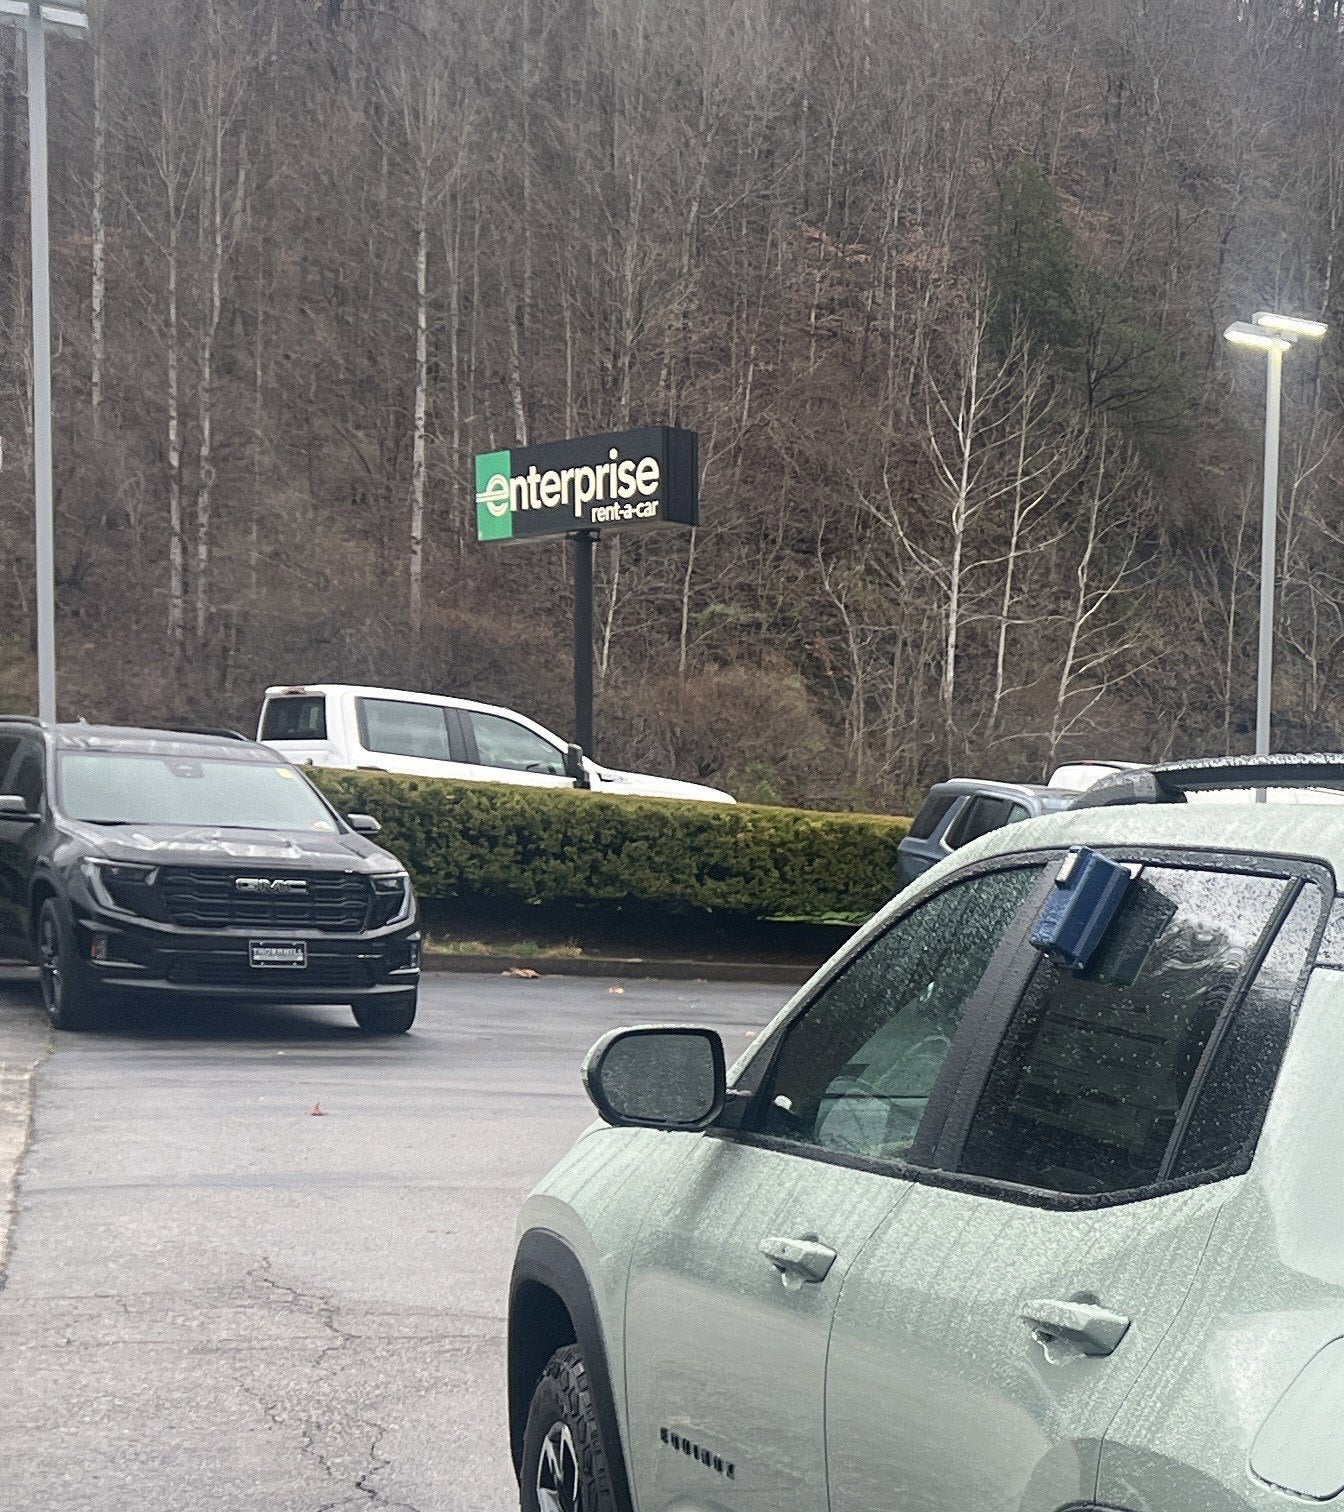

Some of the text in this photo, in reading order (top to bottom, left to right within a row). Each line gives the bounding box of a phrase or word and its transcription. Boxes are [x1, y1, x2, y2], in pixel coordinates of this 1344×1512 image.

[476, 448, 660, 517] enterprise
[591, 499, 659, 523] rent-a-car
[235, 877, 308, 895] GMC
